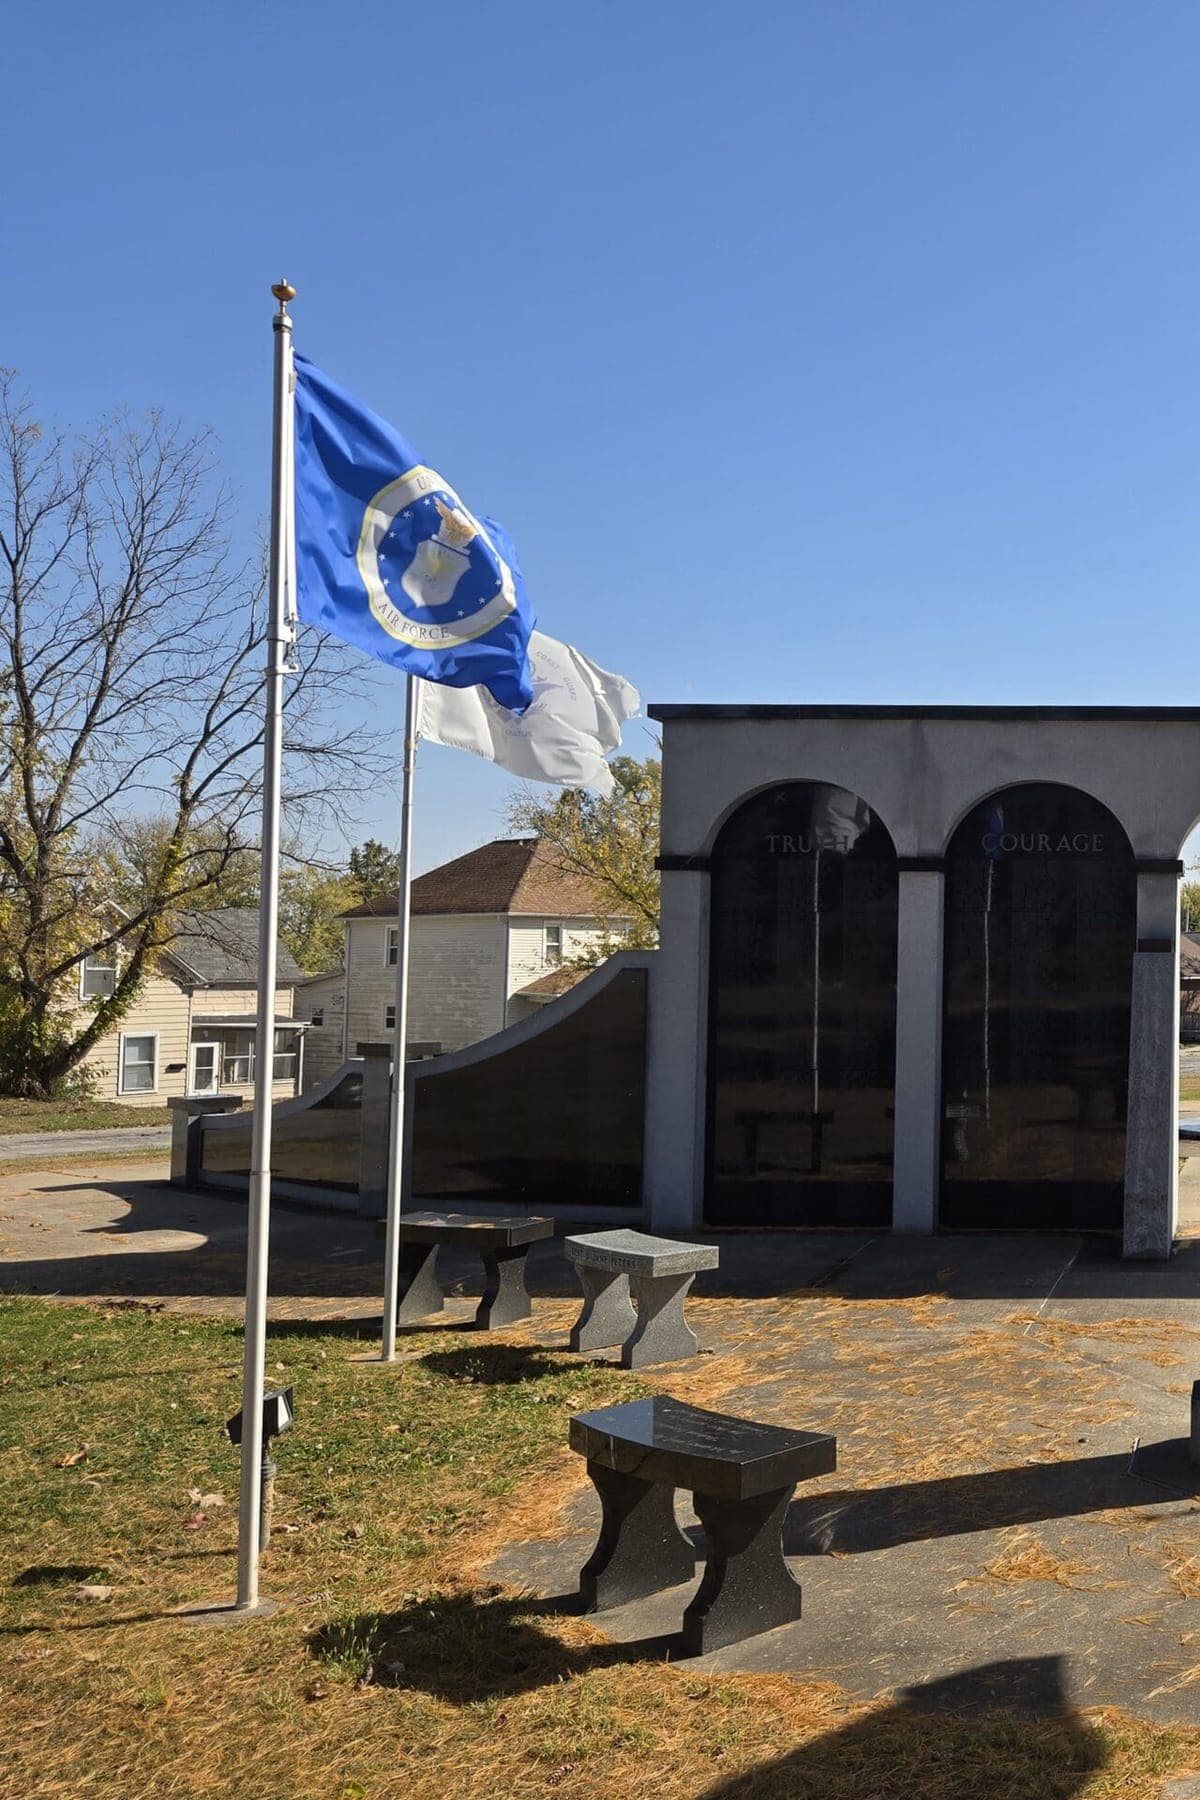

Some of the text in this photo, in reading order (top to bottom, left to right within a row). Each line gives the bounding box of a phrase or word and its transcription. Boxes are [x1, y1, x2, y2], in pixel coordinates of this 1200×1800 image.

[378, 603, 450, 640] AIR FORCE
[981, 833, 1105, 854] COURAGE
